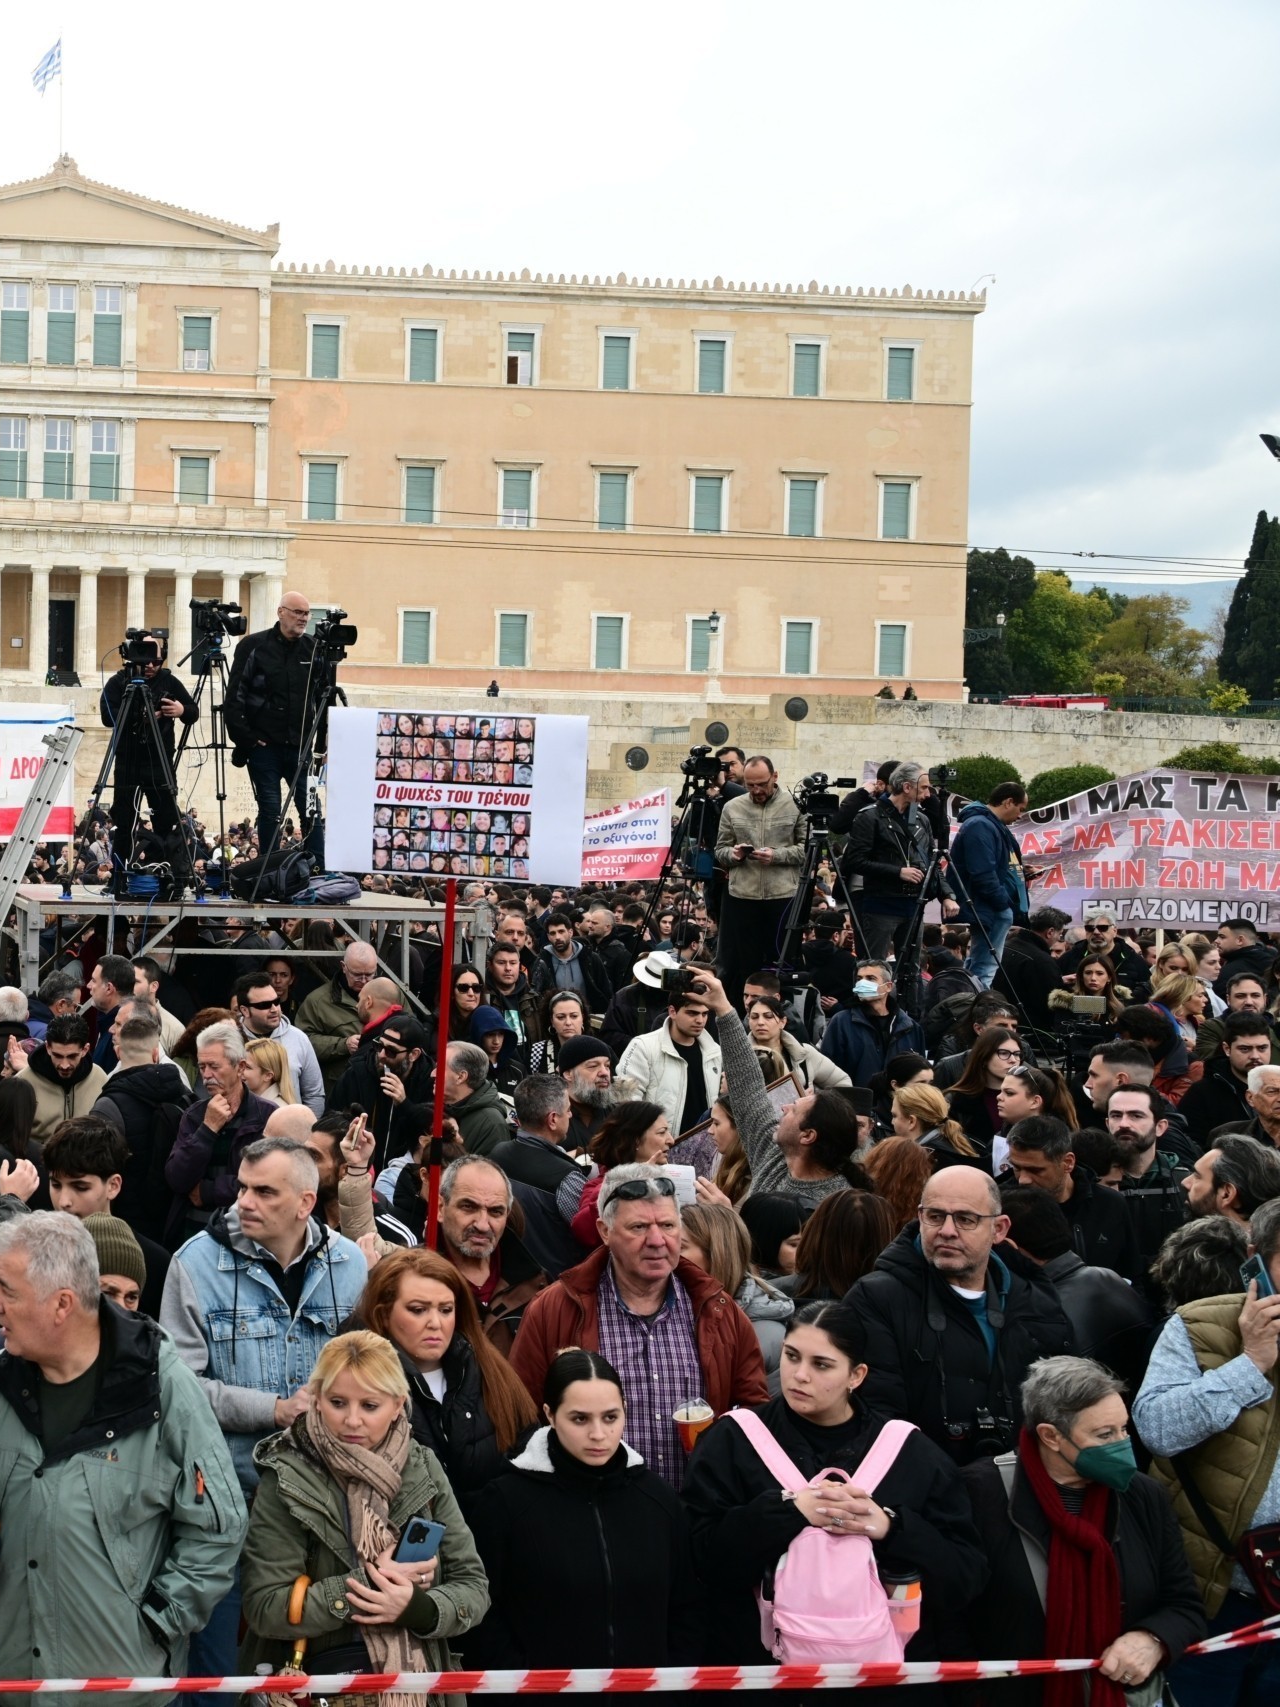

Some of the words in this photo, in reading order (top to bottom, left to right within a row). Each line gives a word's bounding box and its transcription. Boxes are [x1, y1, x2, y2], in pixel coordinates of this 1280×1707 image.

[10, 756, 45, 780] ΔΡΟ
[376, 783, 391, 800] Οι
[394, 785, 442, 803] ψυχές
[447, 789, 474, 804] του
[477, 788, 531, 807] τρένου
[1086, 776, 1175, 817] ΜΑΣ
[1189, 777, 1251, 813] ΤΑ
[631, 818, 659, 827] στην
[588, 837, 600, 845] το
[603, 830, 657, 845] οξυγόνο!
[1017, 830, 1062, 855] ΑΣ
[1072, 821, 1116, 852] ΝΑ
[586, 853, 660, 865] ΠΡΟΣΩΠΙΚΟΥ
[581, 866, 626, 877] ΔΕΥΣΗΣ
[1078, 859, 1146, 890] ΤΗΝ
[1157, 858, 1225, 891] ΖΩΗ
